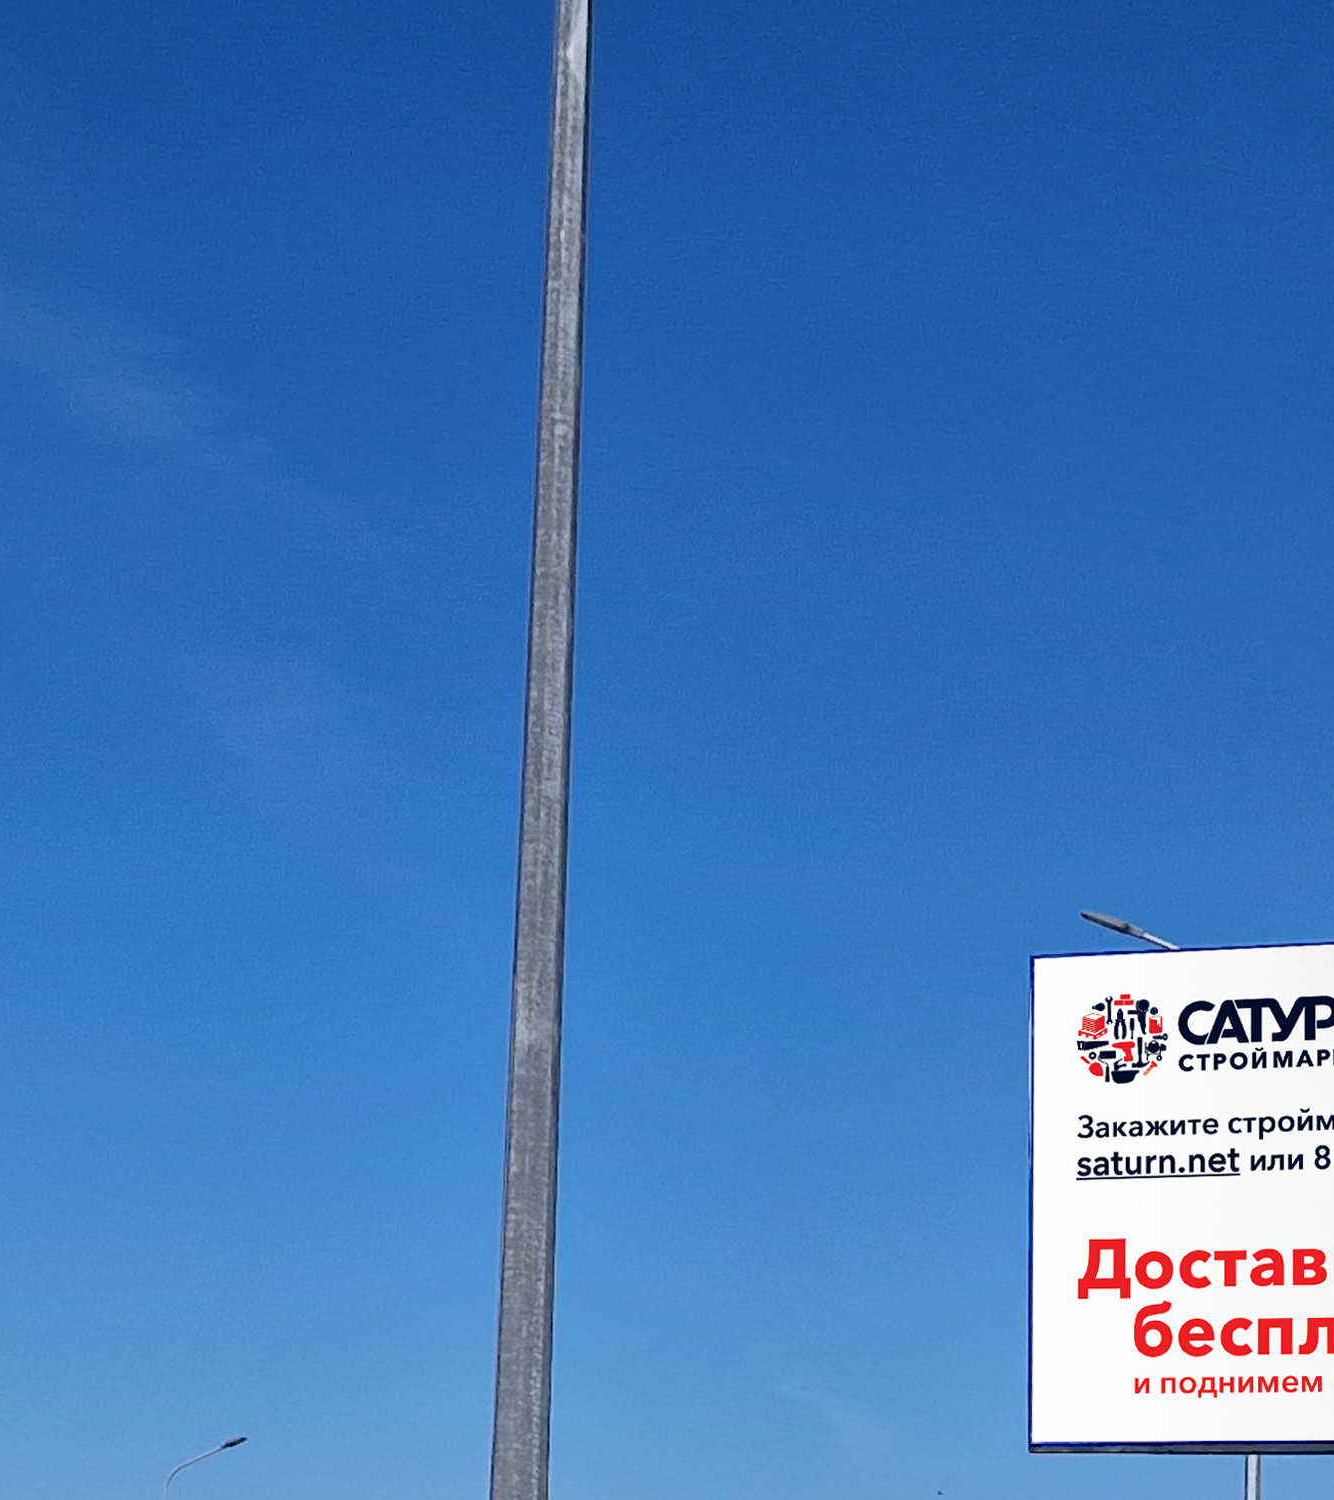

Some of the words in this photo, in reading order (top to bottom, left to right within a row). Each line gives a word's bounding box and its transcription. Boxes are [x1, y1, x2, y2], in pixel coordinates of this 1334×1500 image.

[1078, 1115, 1218, 1139] Закажите
[1076, 1148, 1241, 1180] saturn.net
[1250, 1153, 1304, 1171] или
[1315, 1145, 1331, 1170] 8
[1135, 1377, 1151, 1395] и
[1160, 1375, 1323, 1398] поднимем
